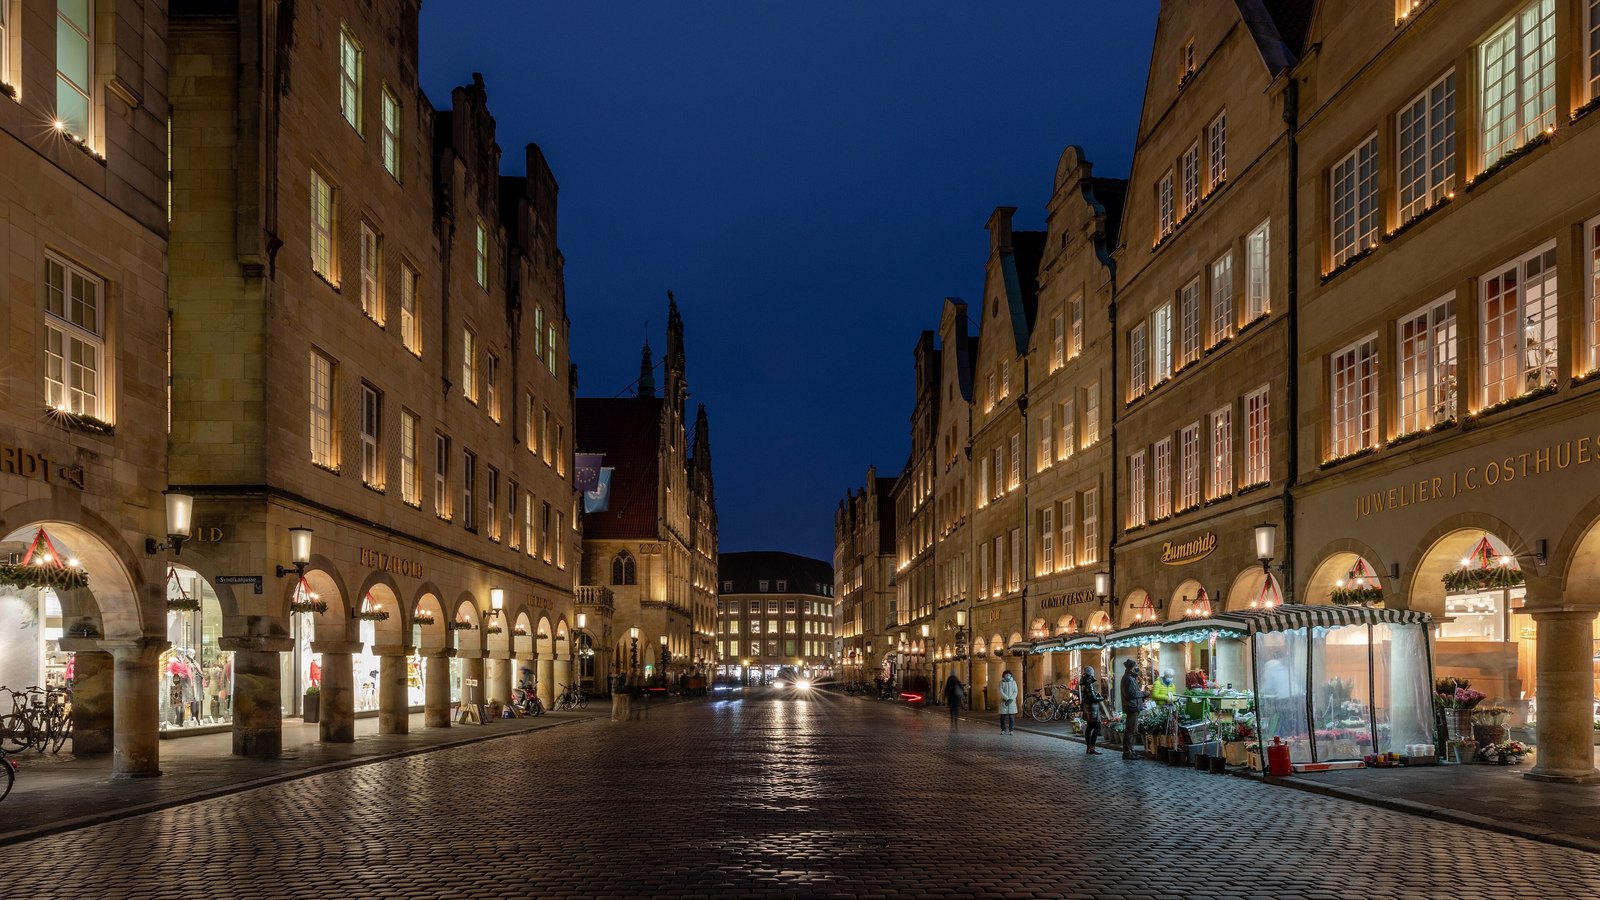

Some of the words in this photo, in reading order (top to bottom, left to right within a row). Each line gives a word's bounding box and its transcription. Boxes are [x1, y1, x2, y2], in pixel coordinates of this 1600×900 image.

[1355, 477, 1442, 520] JUWELIER
[360, 547, 423, 579] PETZHOLD
[1161, 531, 1217, 563] Zumnorde
